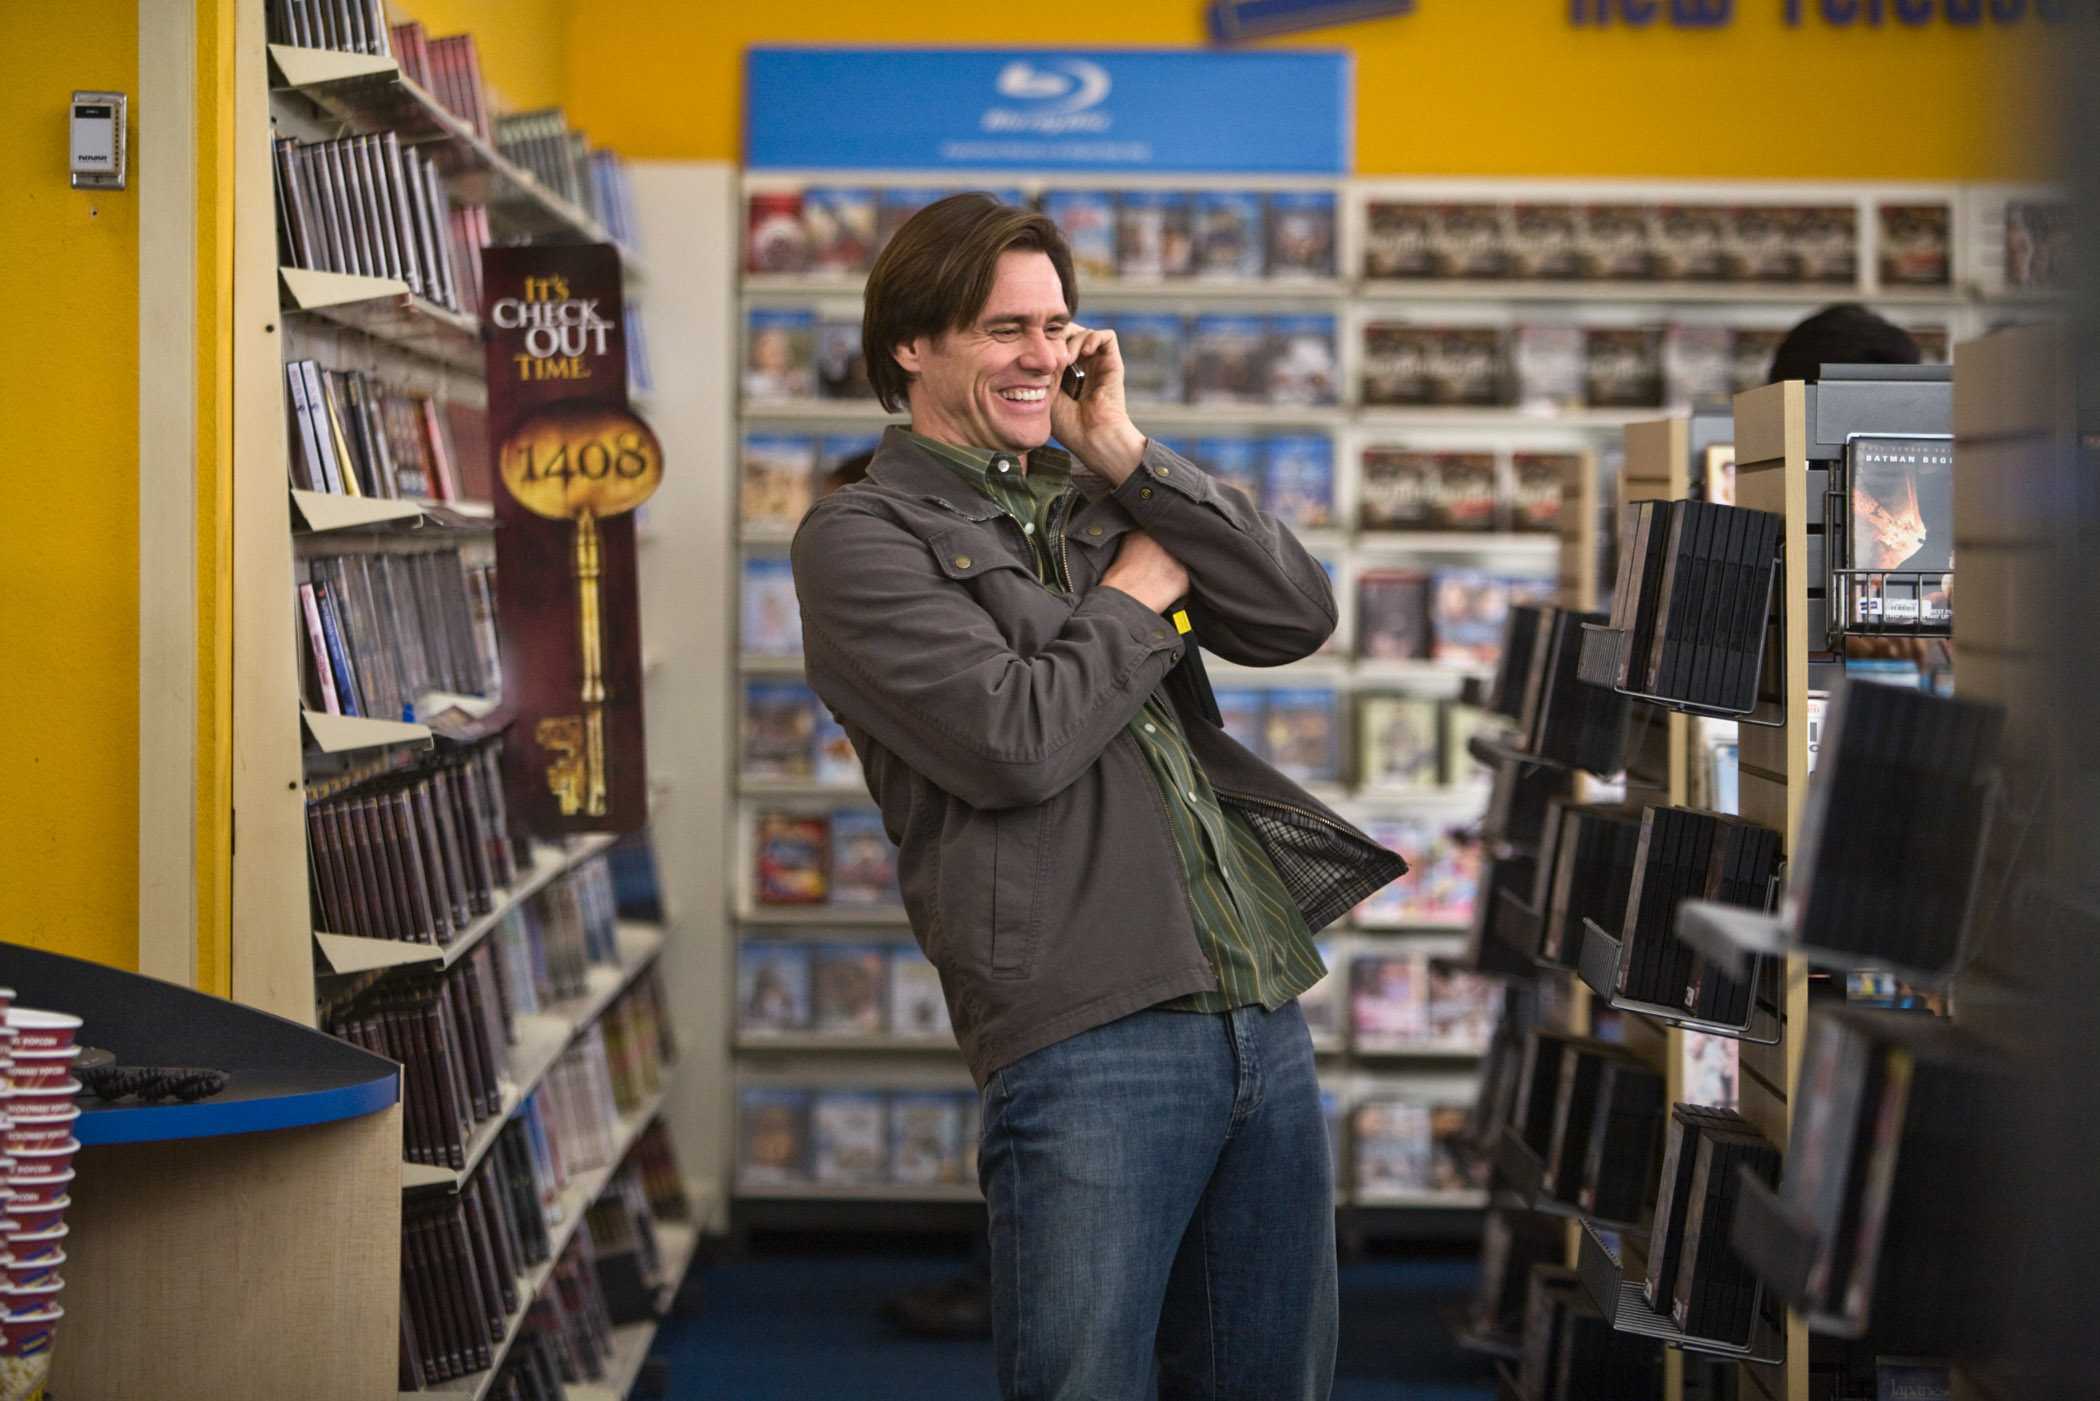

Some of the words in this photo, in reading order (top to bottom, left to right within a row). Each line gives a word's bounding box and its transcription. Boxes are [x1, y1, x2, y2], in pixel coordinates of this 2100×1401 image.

[524, 274, 570, 303] IT'S
[492, 298, 602, 329] CHECK
[525, 321, 615, 359] OUT
[517, 431, 647, 491] 1408
[1865, 454, 1917, 464] BATMAN
